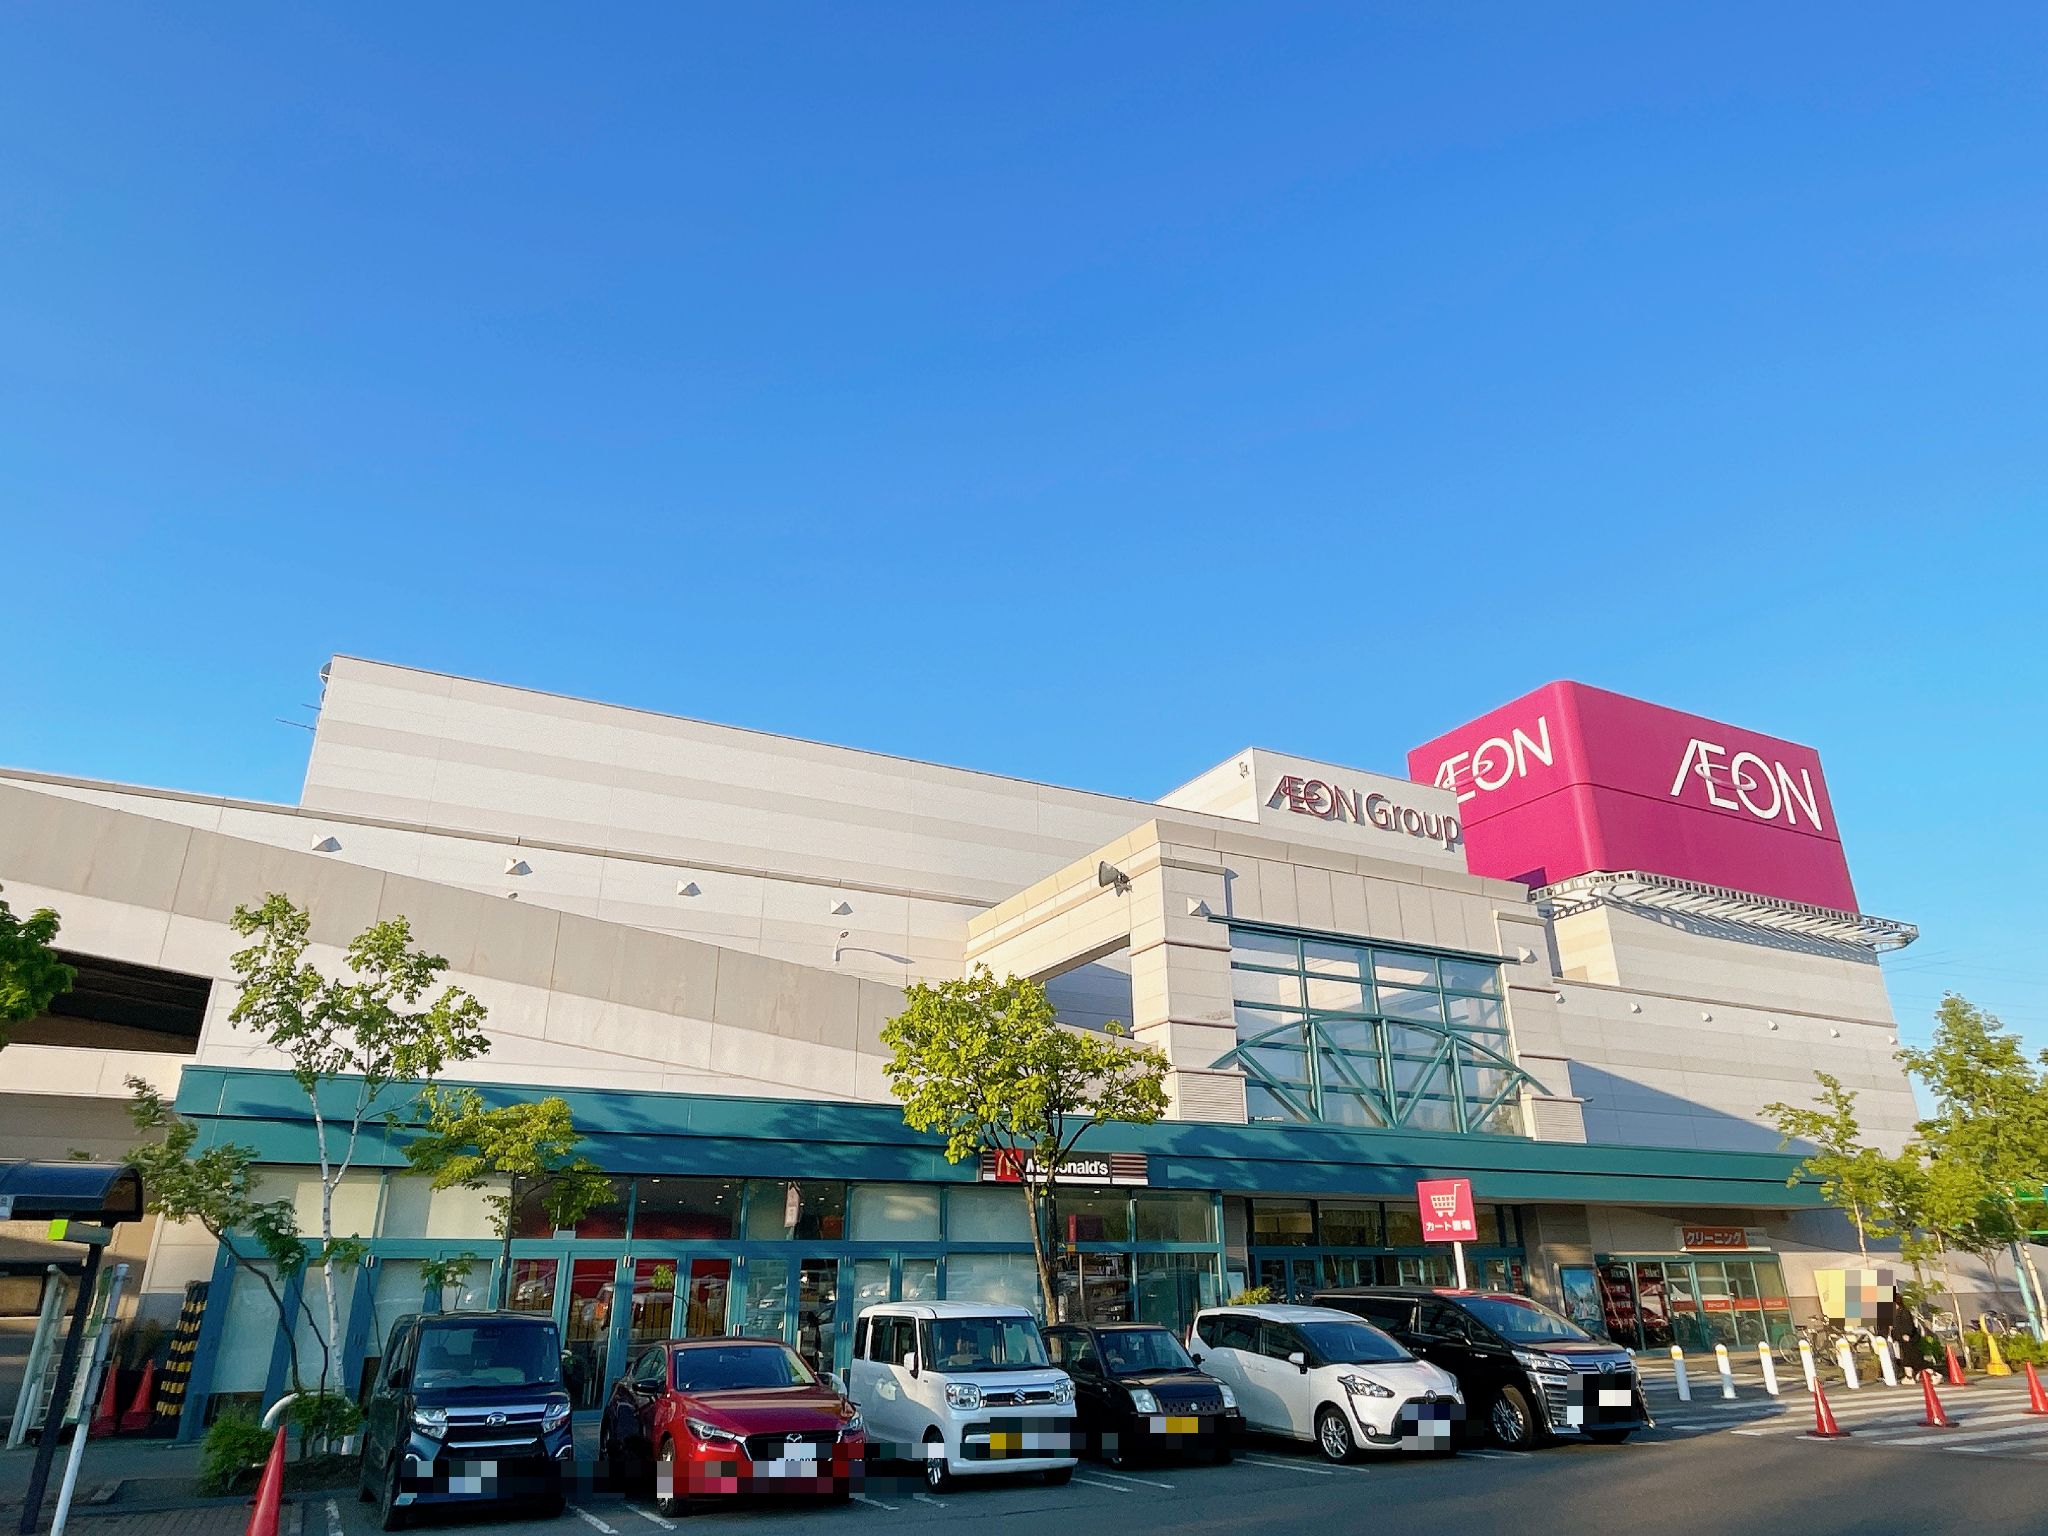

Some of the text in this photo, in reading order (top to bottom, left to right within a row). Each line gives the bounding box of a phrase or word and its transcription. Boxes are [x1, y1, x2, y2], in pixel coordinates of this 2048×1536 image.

[1366, 792, 1460, 850] Group
[1025, 1158, 1109, 1176] Mconald's
[1686, 1231, 1742, 1246] クリーニング
